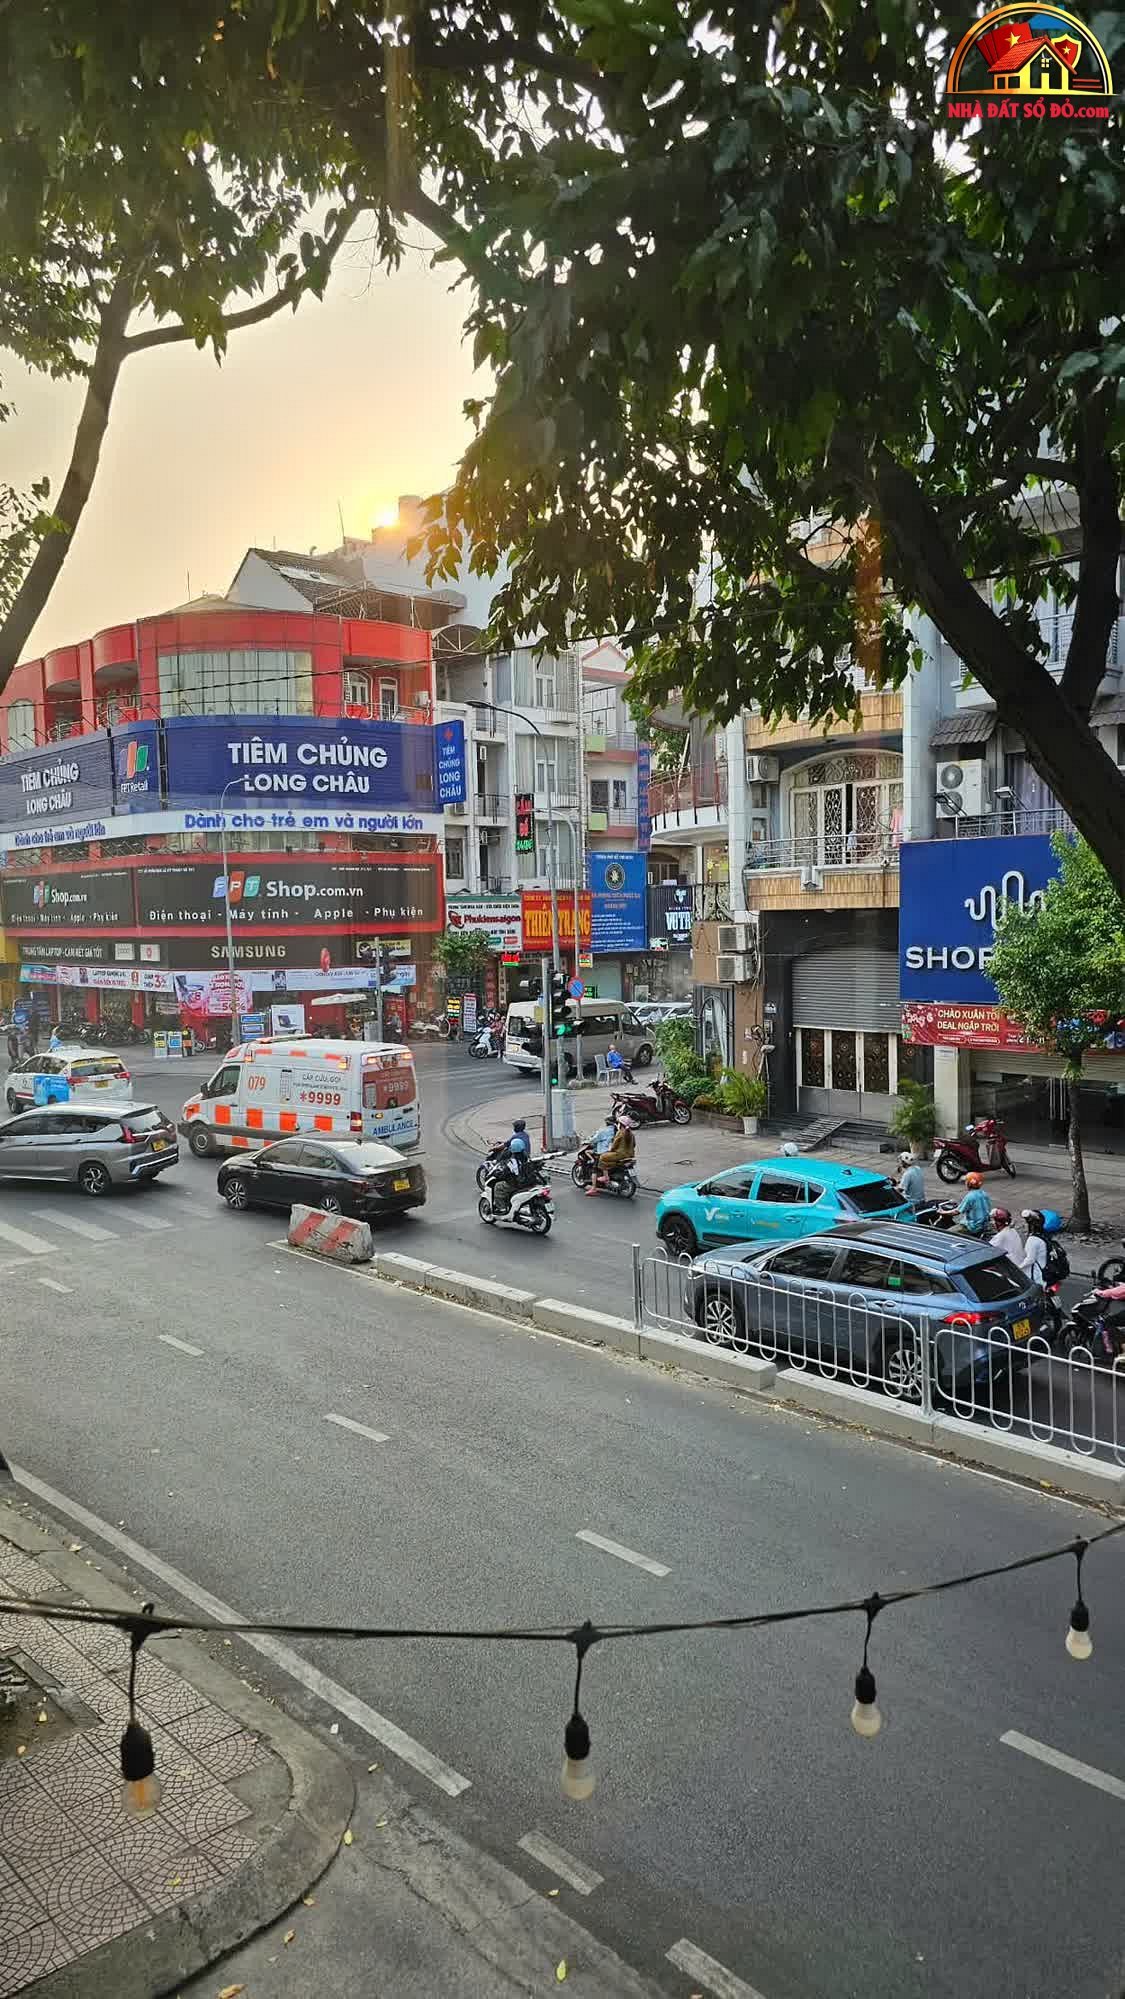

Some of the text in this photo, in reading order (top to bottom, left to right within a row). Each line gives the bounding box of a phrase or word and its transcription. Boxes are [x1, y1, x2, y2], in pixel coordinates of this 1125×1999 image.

[227, 736, 388, 768] TIÊM CHỦNG
[21, 758, 79, 792] TIÊM CHỦNG
[244, 771, 370, 793] LONG CHÂU
[440, 771, 460, 784] LONG
[440, 783, 462, 798] CHÂU
[27, 789, 72, 814] LONG CHÂU
[185, 811, 423, 832] Dành cho trẻ em và người lớn
[266, 880, 363, 900] Shop.com.vn
[150, 907, 423, 923] Điện thoại Máy tính Apple Phụ kiện
[211, 945, 286, 958] SAMSUNG
[937, 1008, 961, 1019] CHÀO
[962, 1009, 985, 1020] XUÂN
[937, 1021, 957, 1030] DEAL
[248, 1075, 266, 1090] 079
[373, 1119, 414, 1136] AMBULANCE
